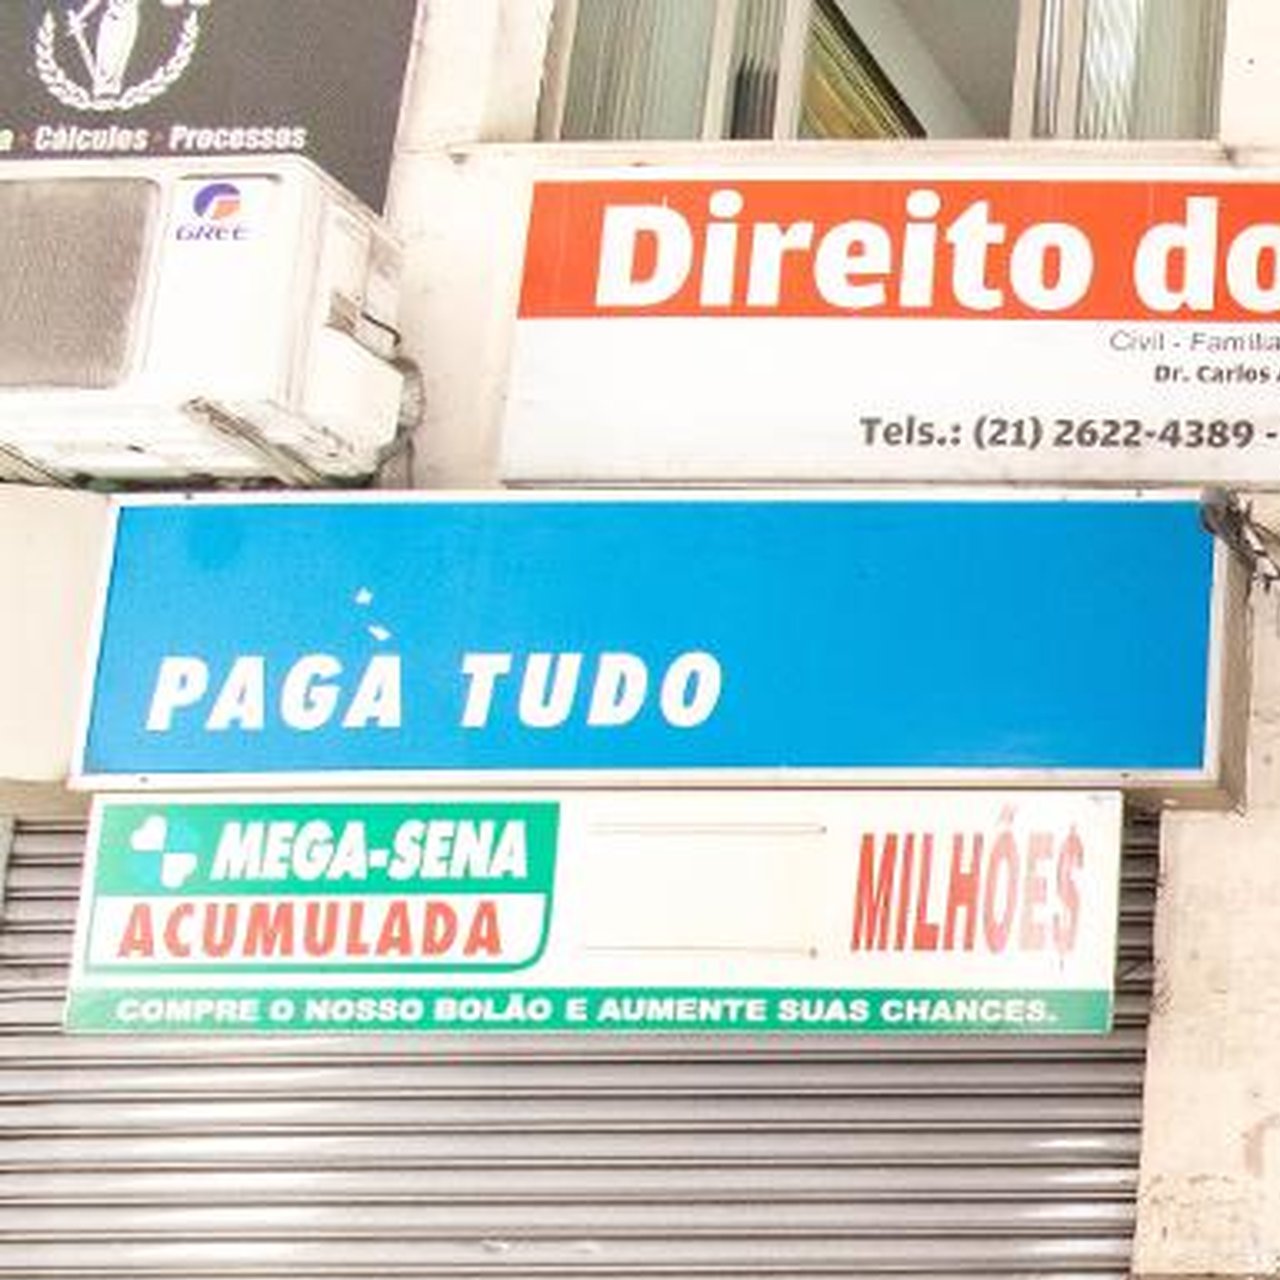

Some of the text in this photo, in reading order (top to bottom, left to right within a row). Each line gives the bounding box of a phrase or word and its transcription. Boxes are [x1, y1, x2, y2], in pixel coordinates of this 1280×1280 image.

[168, 125, 308, 150] Processos
[595, 189, 1094, 311] Direito
[1109, 330, 1165, 352] Civil
[1154, 364, 1190, 383] Dr.
[1196, 364, 1271, 384] Carlos
[860, 416, 961, 447] Tels.:
[973, 415, 1043, 451] (21)
[1053, 417, 1254, 449] 2622-4389
[459, 651, 723, 728] TUDO
[209, 818, 529, 881] MEGA-SENA
[116, 900, 503, 958] ACUMULADA
[117, 993, 1057, 1022] COMPRE O NOSSO BOLÃO E AUMENTE SUAS CHANCES.
